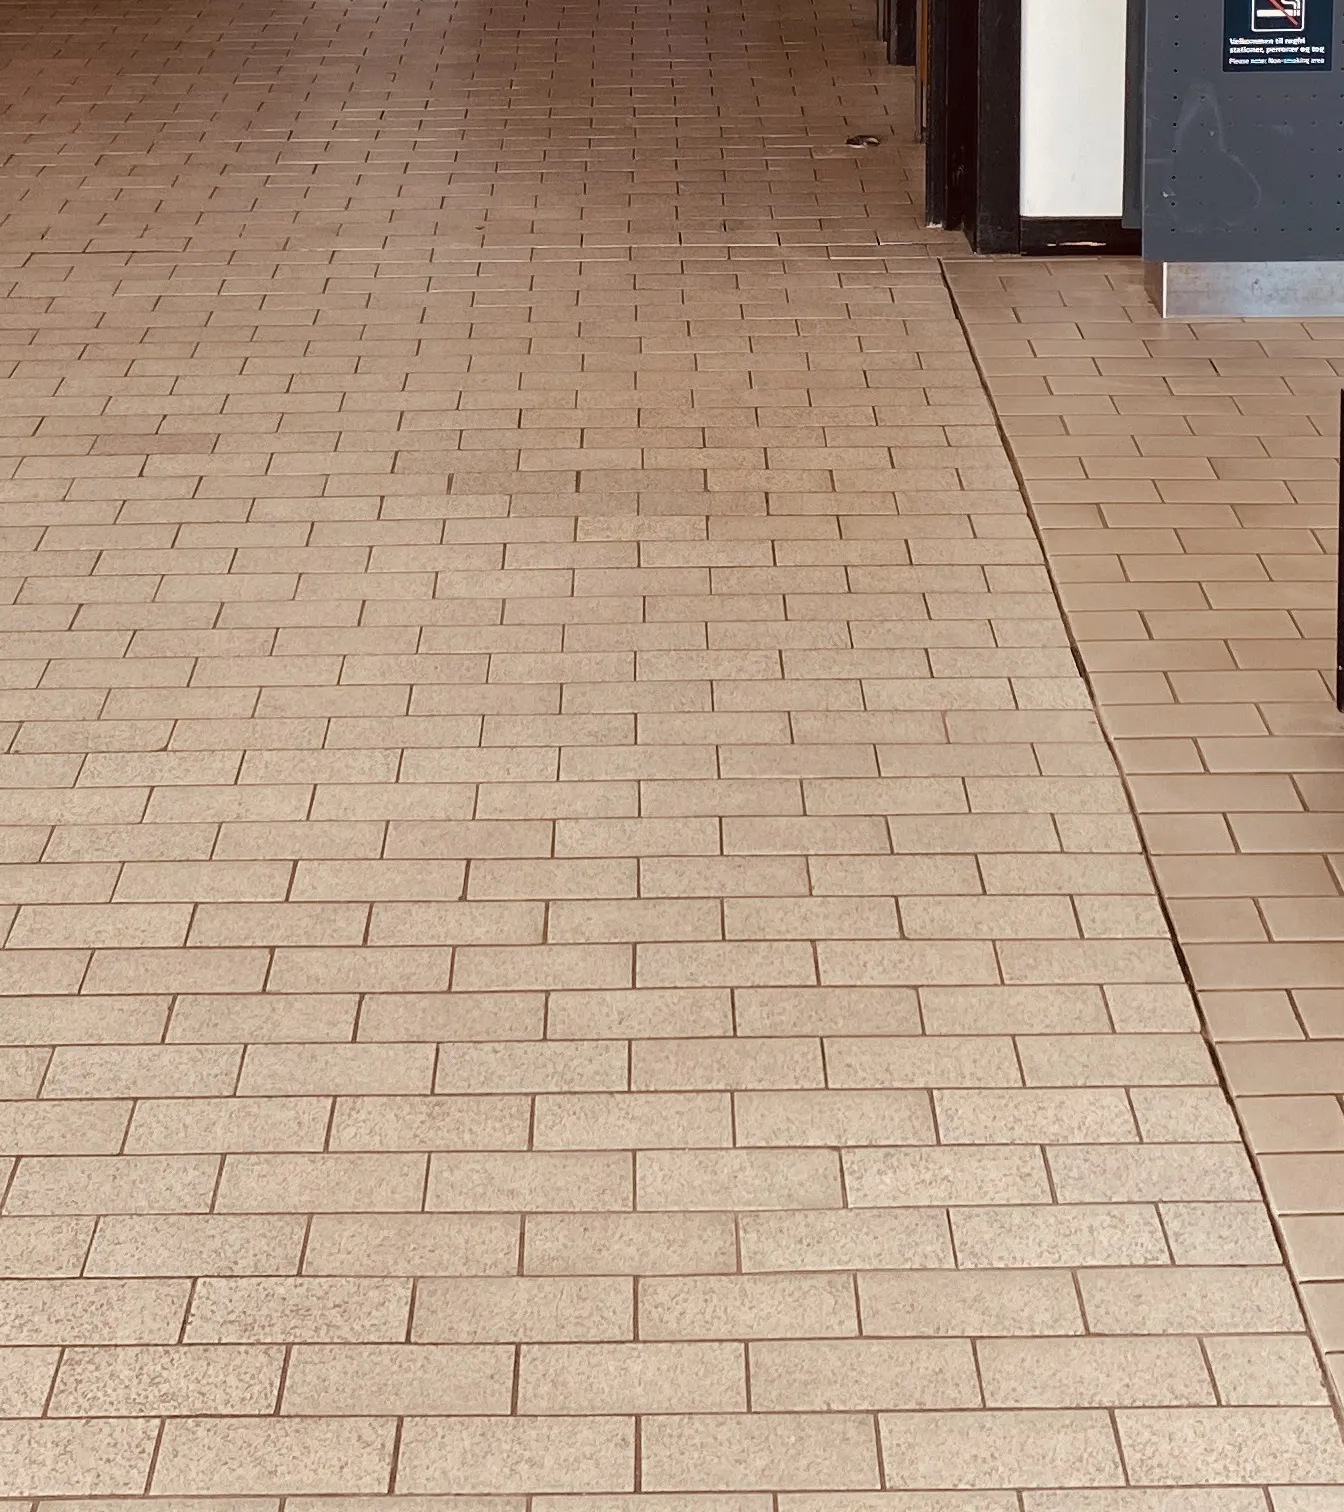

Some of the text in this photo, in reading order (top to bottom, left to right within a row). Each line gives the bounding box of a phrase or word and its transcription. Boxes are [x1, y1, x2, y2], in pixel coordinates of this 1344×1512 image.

[1229, 37, 1274, 45] Velkommen
[1275, 37, 1284, 45] til
[1229, 46, 1325, 55] stationer, perroner og tog
[1228, 57, 1250, 65] Please
[1267, 57, 1310, 65] Non-smoking
